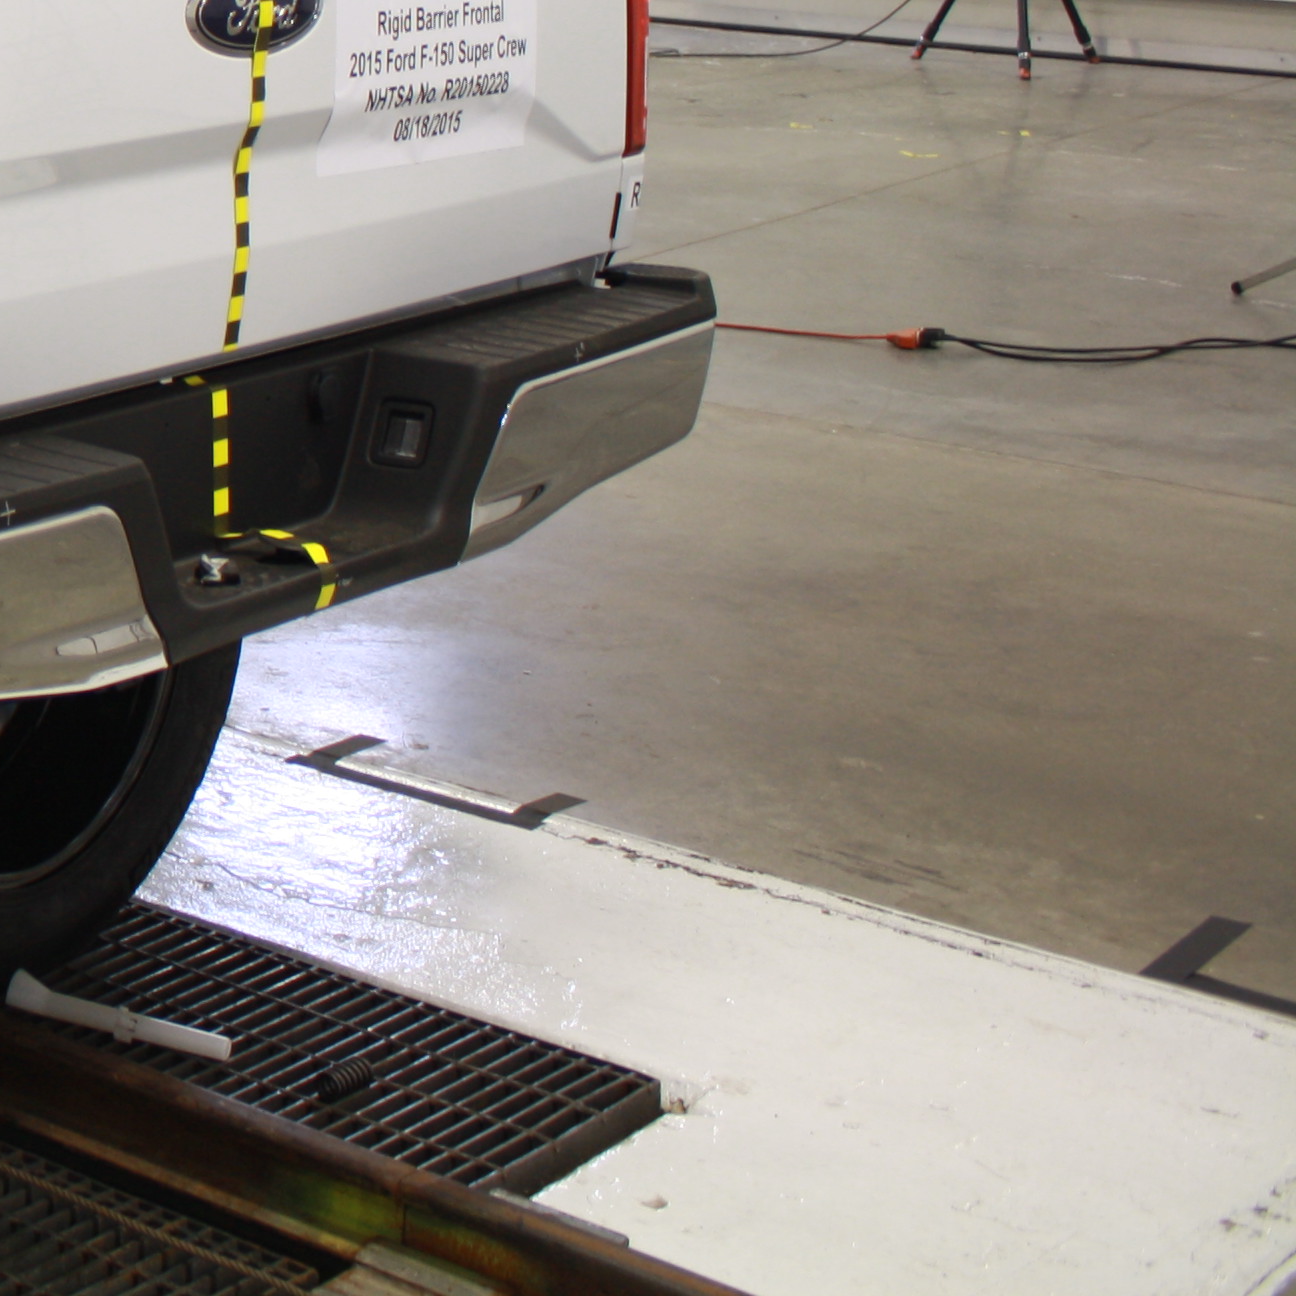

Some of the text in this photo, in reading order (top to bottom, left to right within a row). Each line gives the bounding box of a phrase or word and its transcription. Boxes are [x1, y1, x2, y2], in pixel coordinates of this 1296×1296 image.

[378, 7, 412, 41] Rigid
[416, 4, 459, 31] Barrier
[349, 36, 527, 79] 2015 Ford F-150 Super Crew
[365, 71, 510, 112] NHTSA No. R20150228
[393, 110, 464, 142] 08/18/2015
